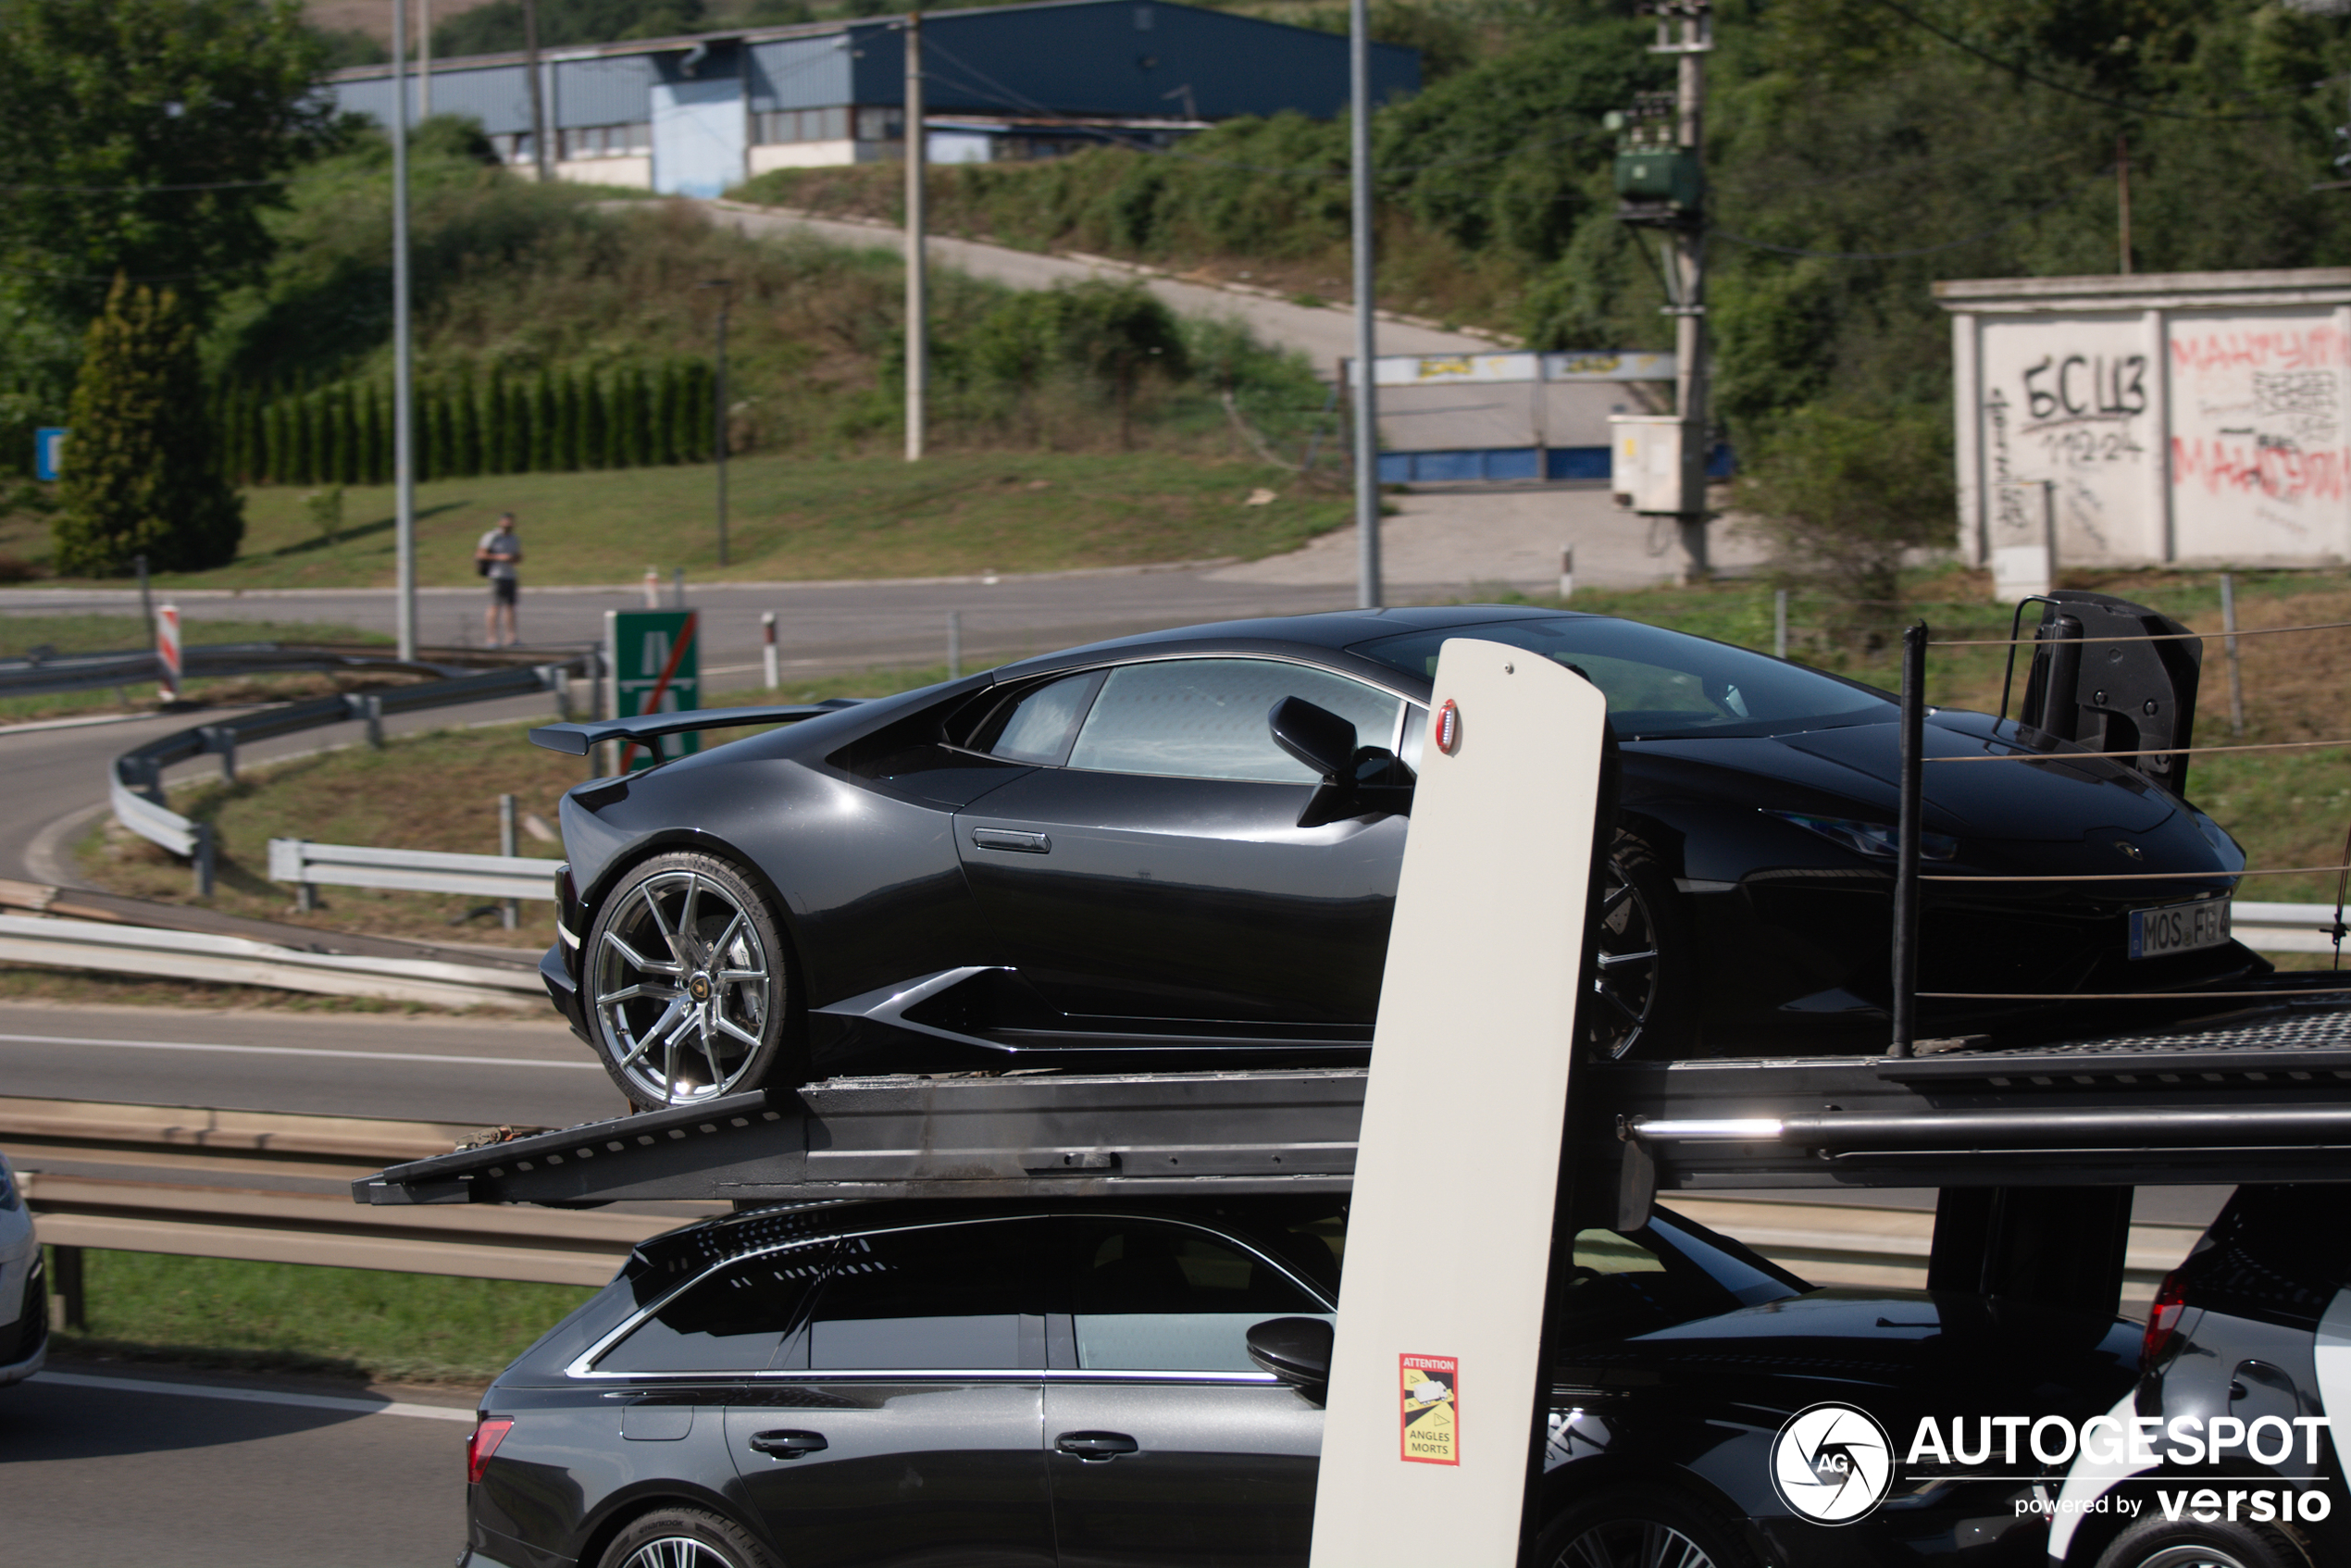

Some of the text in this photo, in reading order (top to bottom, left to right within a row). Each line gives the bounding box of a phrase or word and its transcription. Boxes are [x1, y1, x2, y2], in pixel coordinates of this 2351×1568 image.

[2143, 911, 2183, 952] MOS
[1403, 1357, 1454, 1370] ATTENTION
[1410, 1430, 1450, 1442] ANGLES
[1412, 1442, 1449, 1455] MORTS
